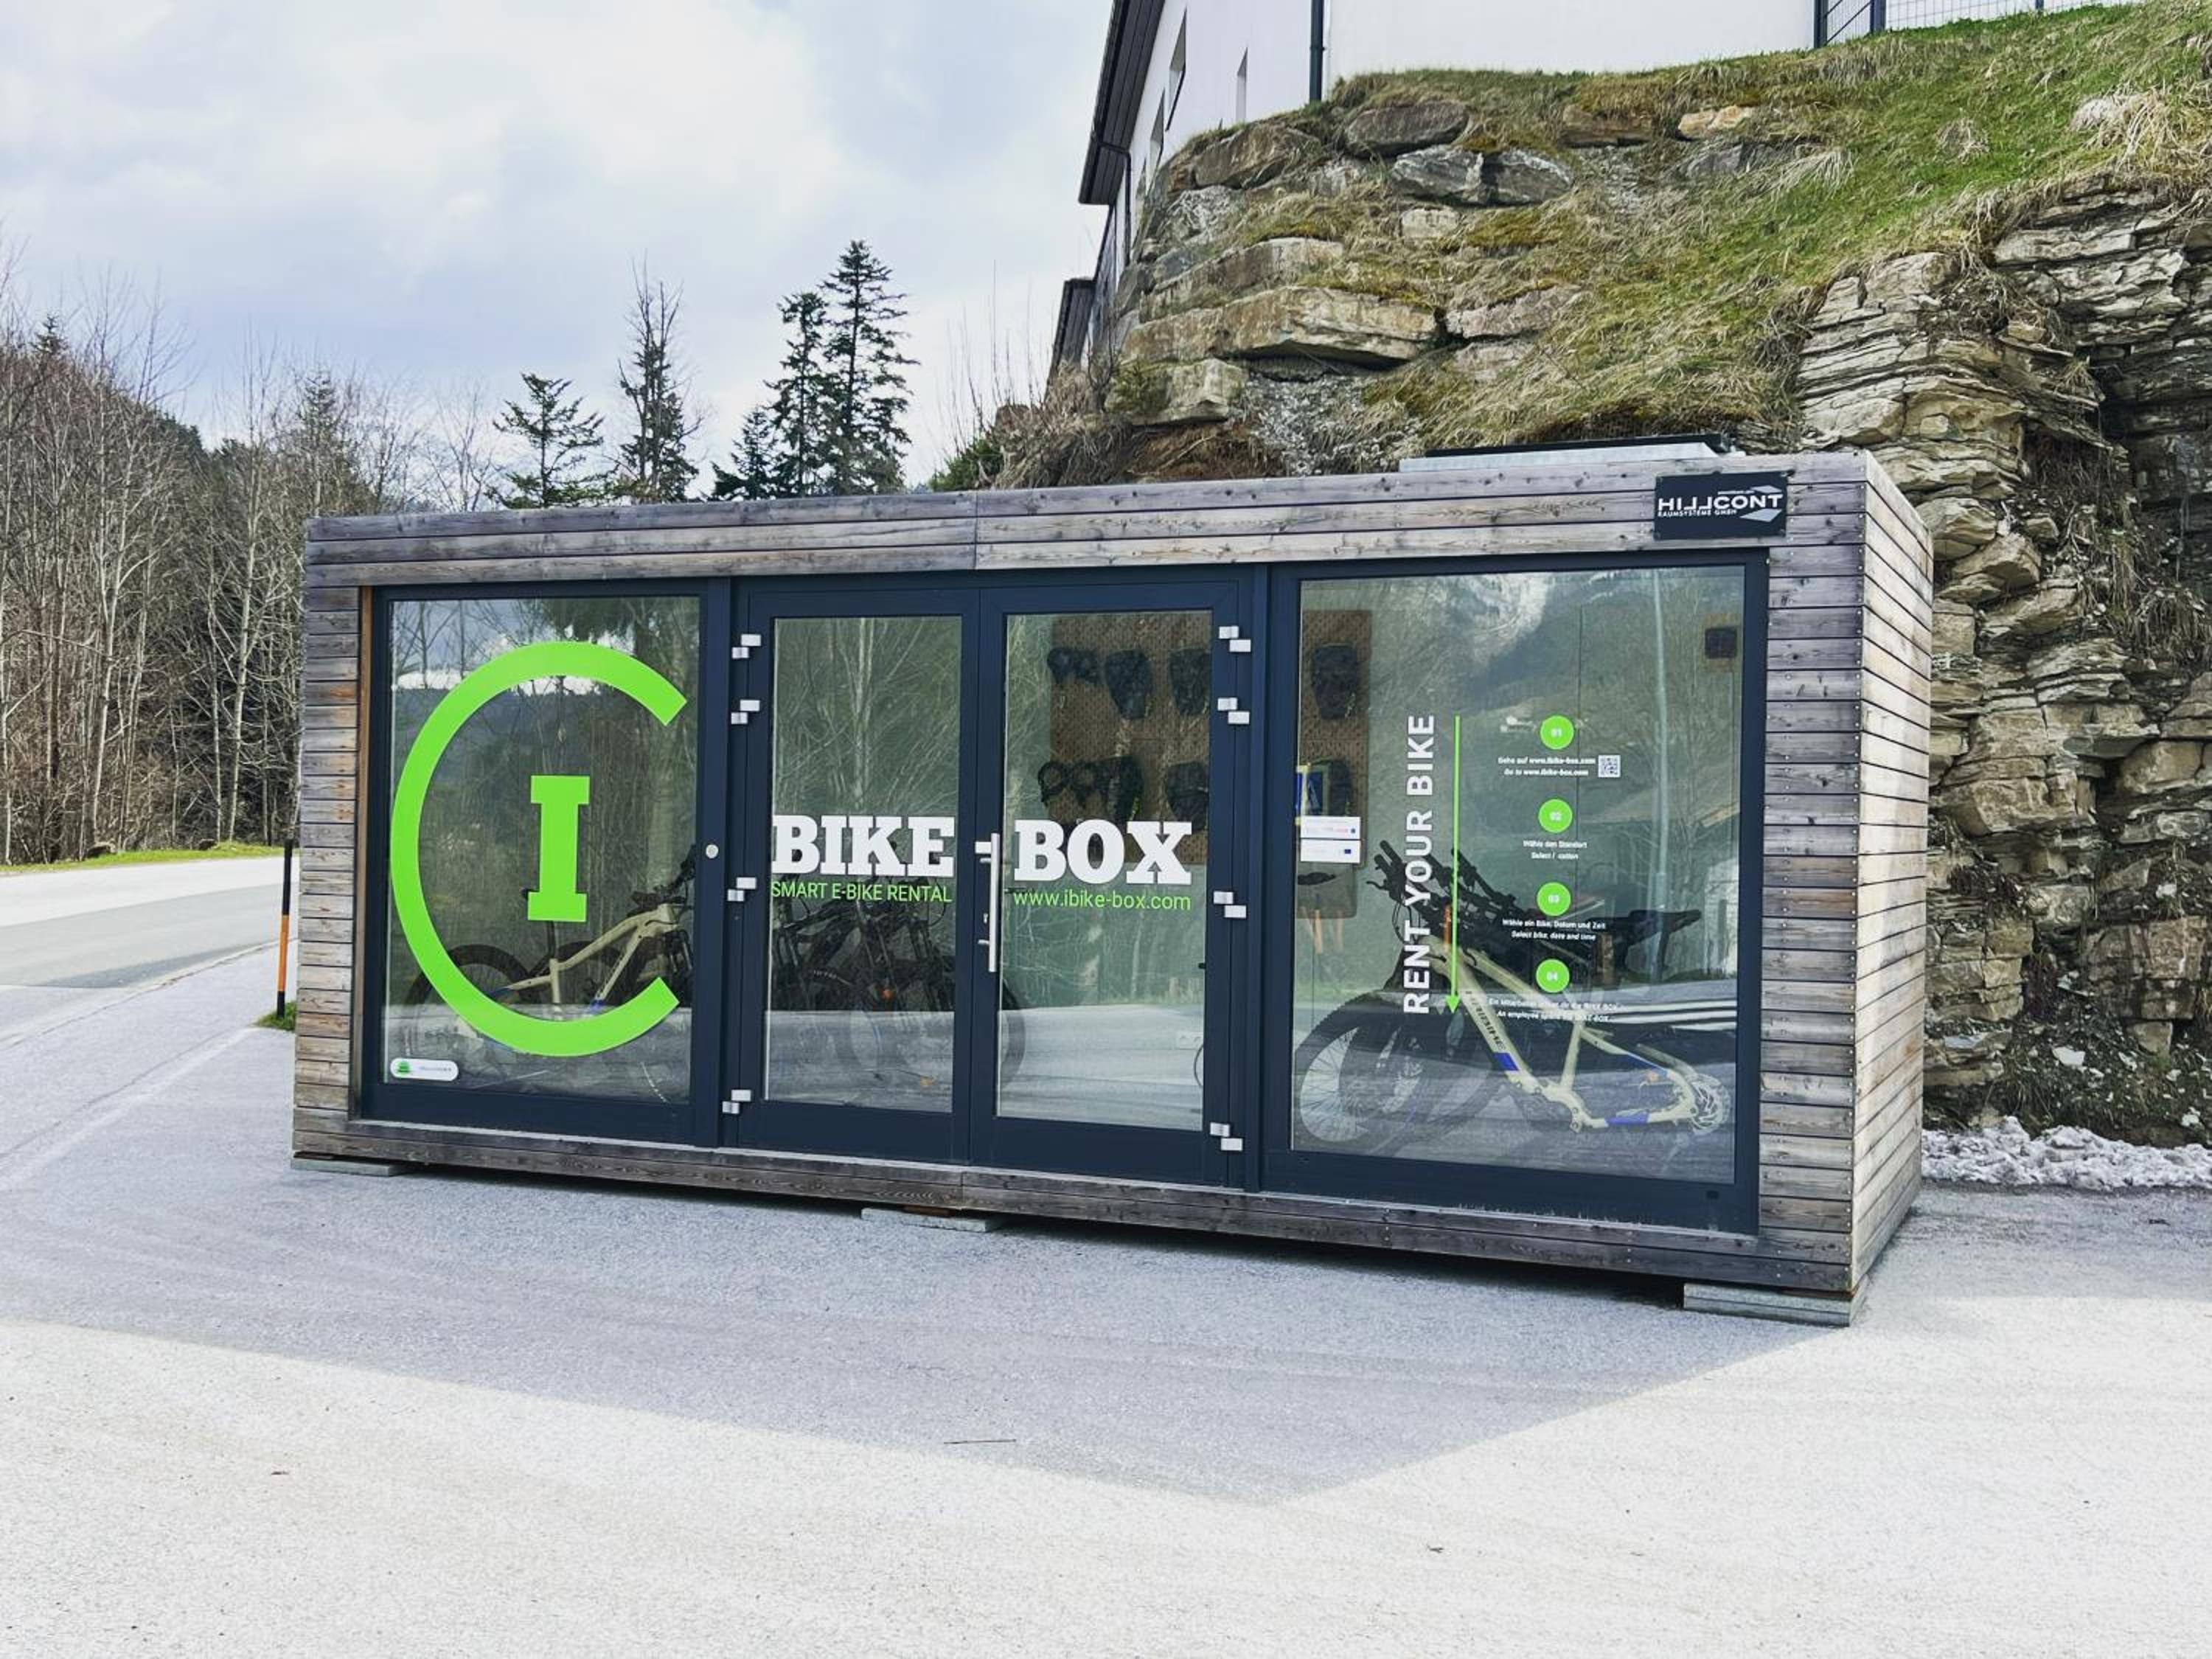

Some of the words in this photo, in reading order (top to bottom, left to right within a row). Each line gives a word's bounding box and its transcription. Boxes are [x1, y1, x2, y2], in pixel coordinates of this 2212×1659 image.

[1407, 715, 1434, 796] BIKE
[771, 814, 955, 877] BIKE
[1014, 819, 1193, 885] BOX
[1405, 810, 1433, 908] YOUR
[771, 881, 830, 900] SMART
[831, 883, 883, 901] E-BIKE
[886, 885, 953, 903] RENTAL
[1014, 888, 1192, 911] www.ibike-box.com
[1403, 920, 1430, 1014] RENT
